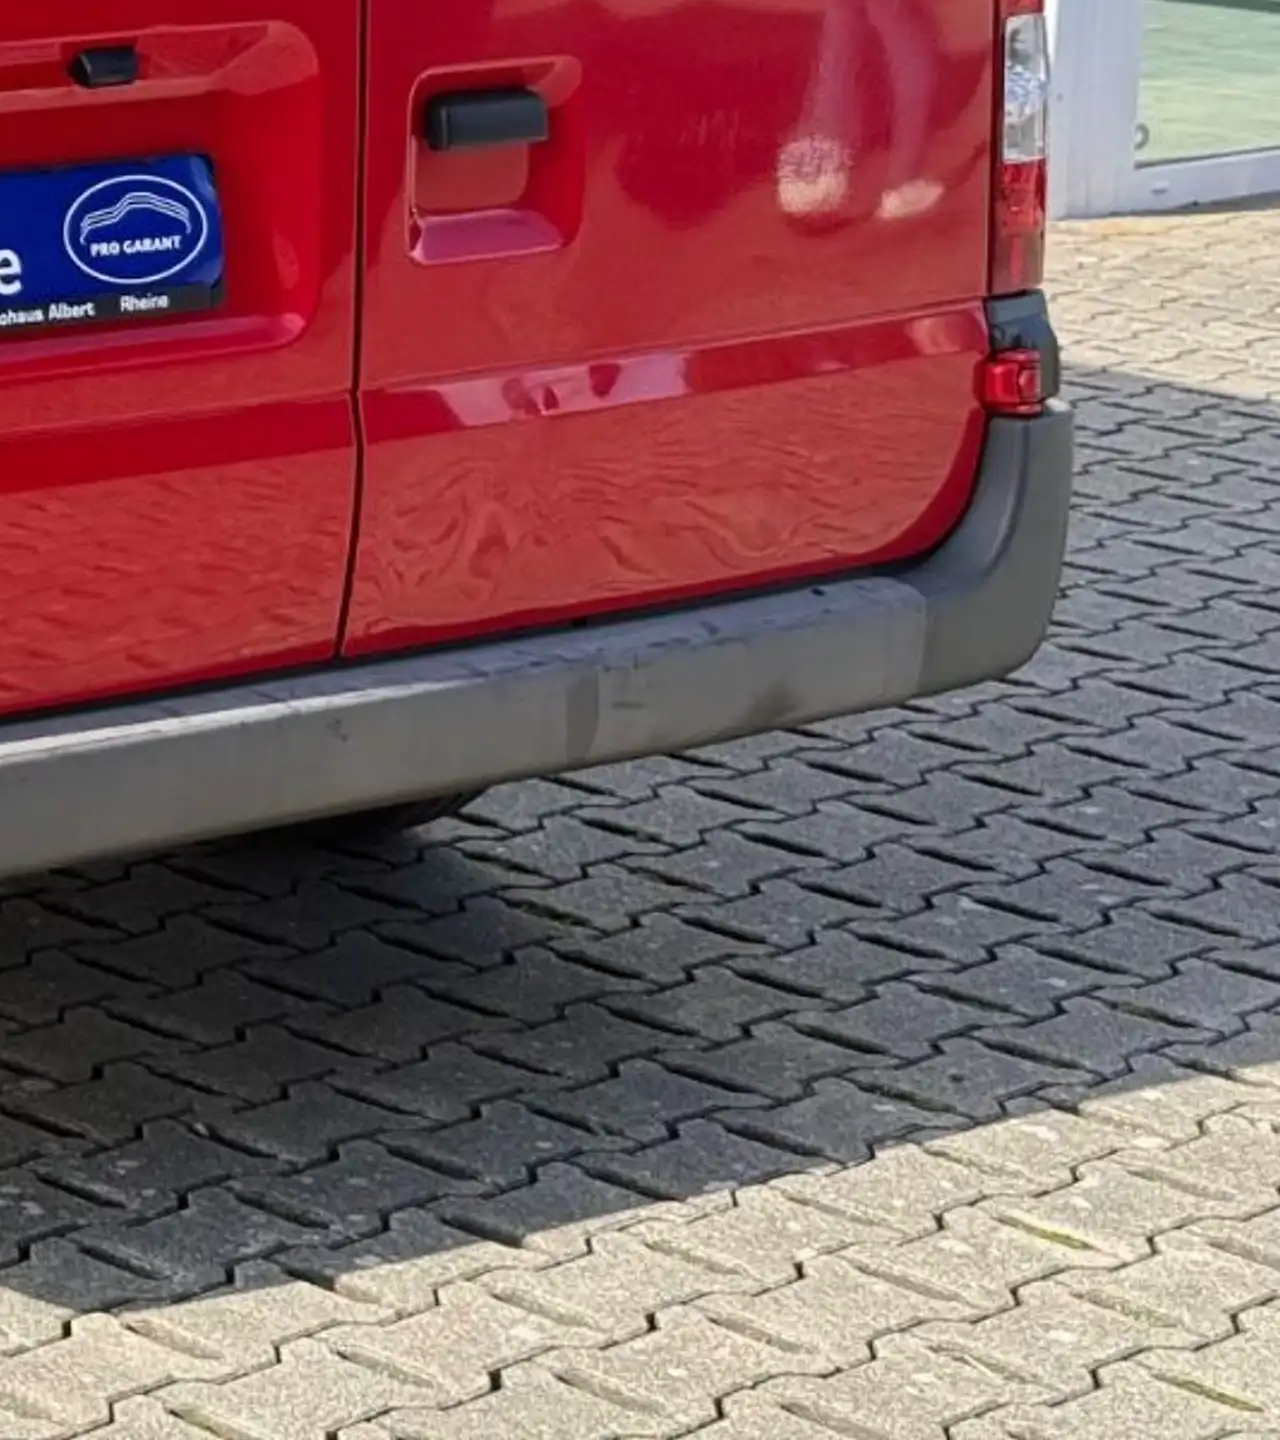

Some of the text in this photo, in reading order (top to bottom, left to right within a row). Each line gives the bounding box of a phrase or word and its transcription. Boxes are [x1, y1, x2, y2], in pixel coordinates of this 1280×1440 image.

[90, 235, 183, 257] PRO GARANT
[48, 302, 97, 321] Albert
[120, 295, 170, 313] Rheine
